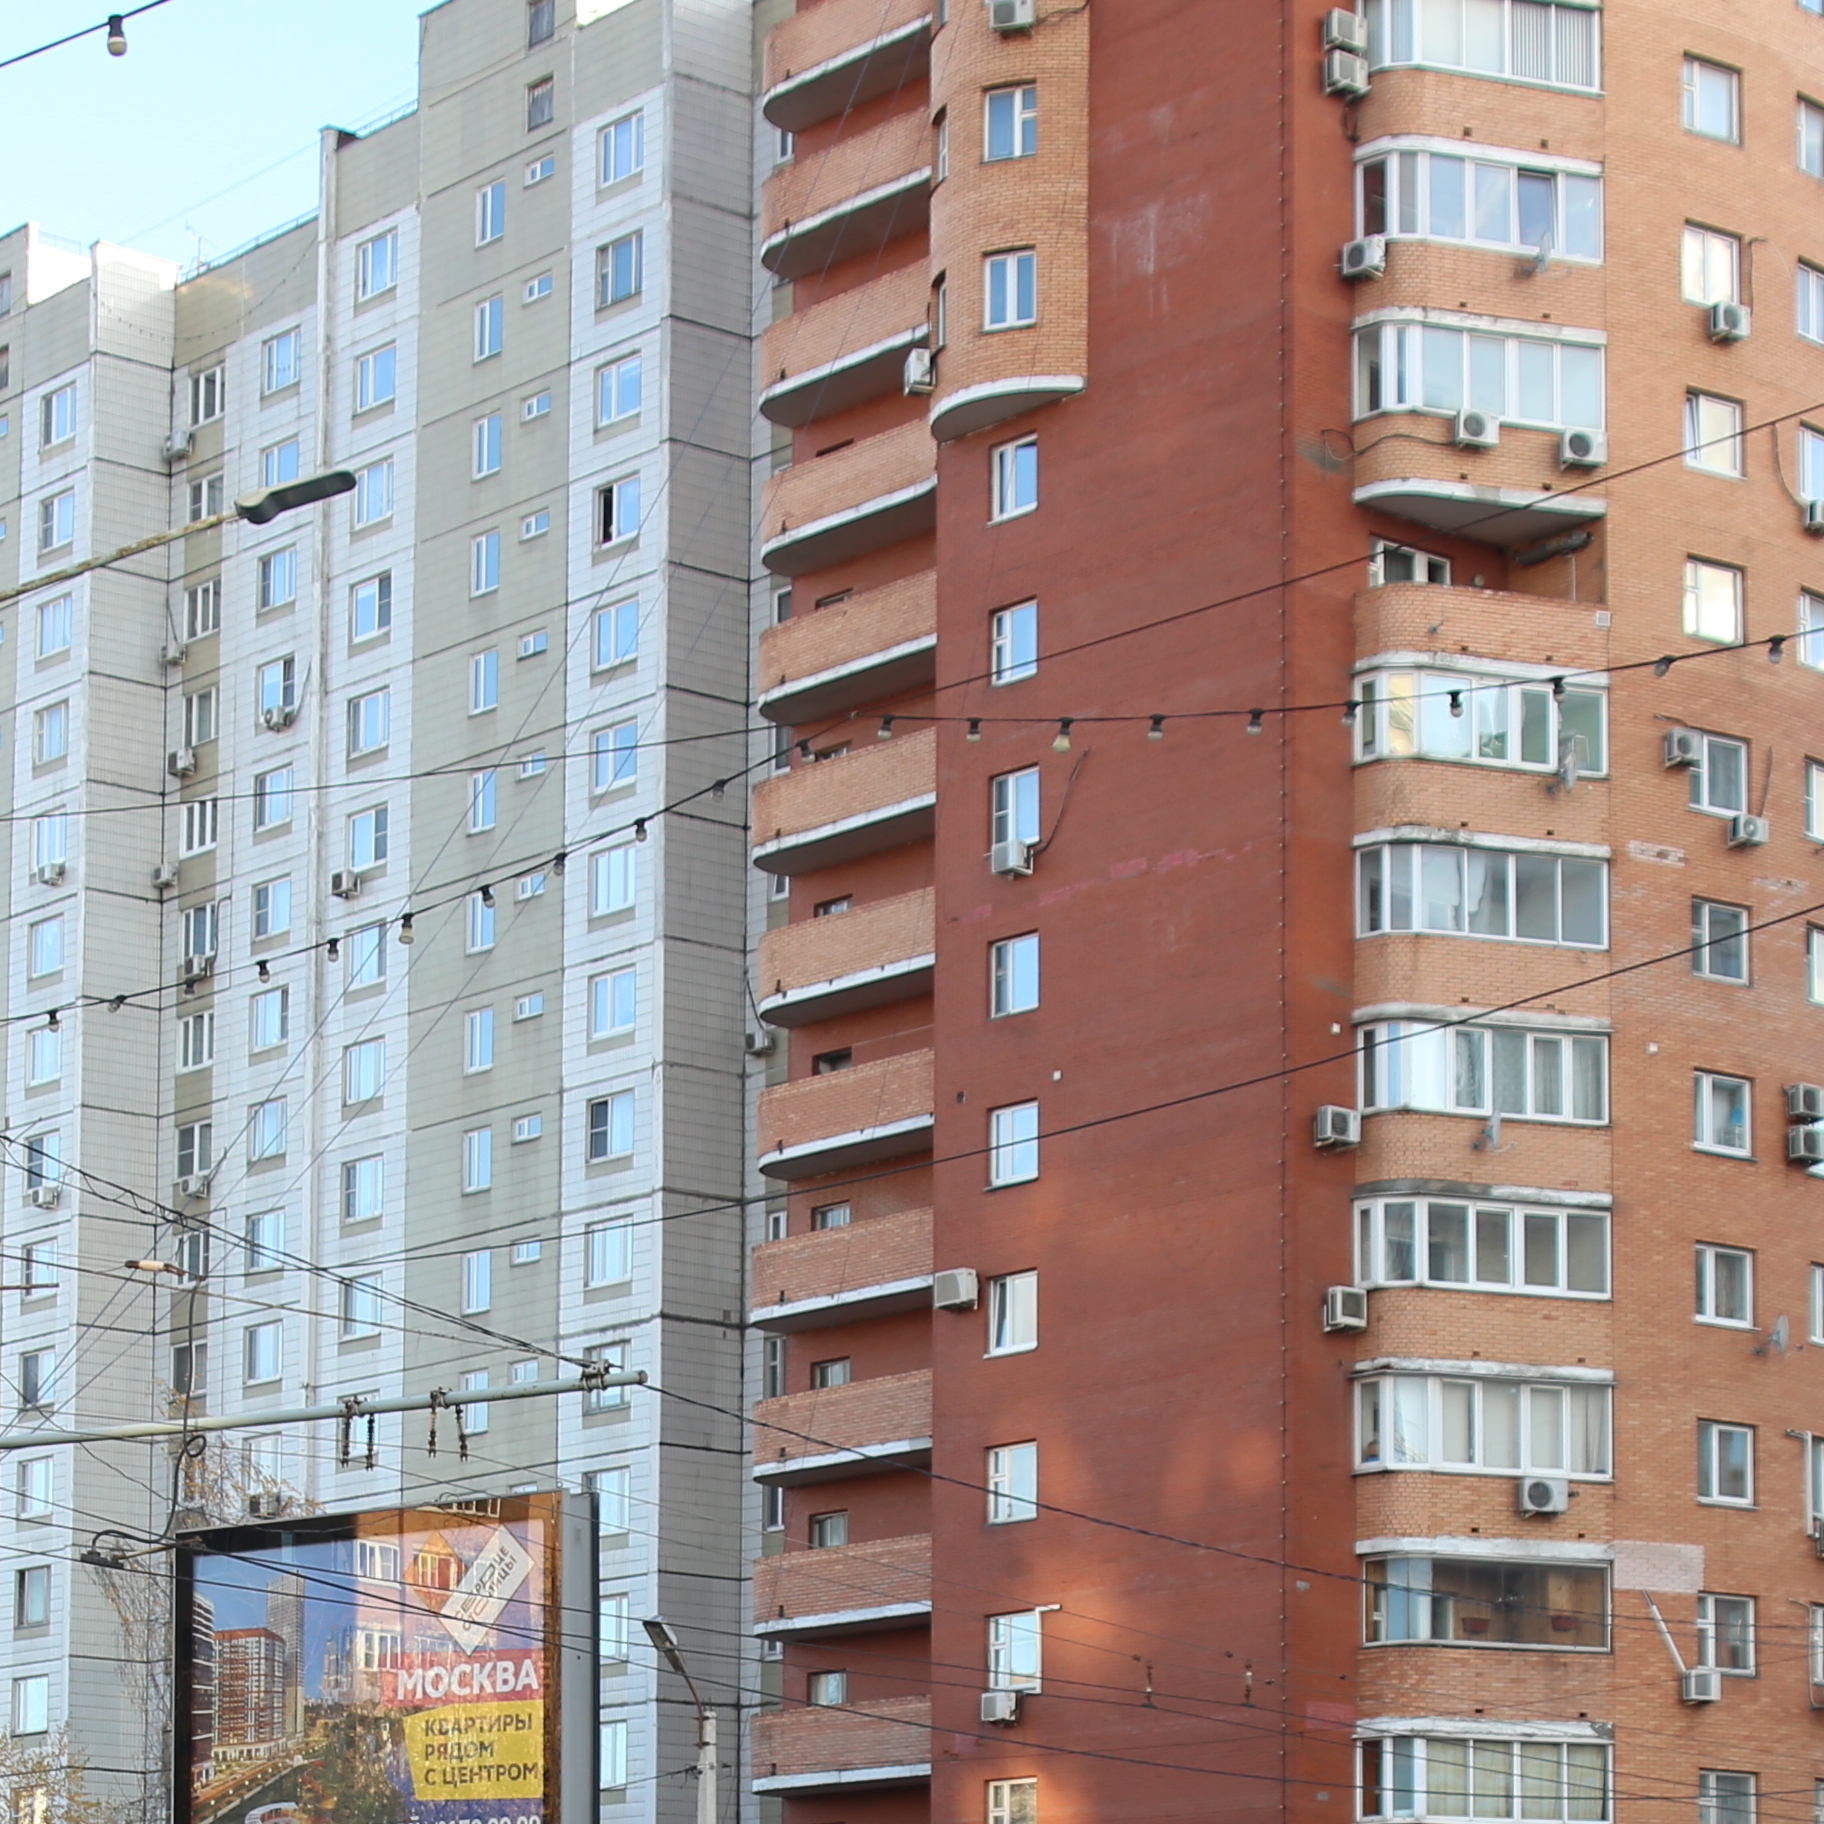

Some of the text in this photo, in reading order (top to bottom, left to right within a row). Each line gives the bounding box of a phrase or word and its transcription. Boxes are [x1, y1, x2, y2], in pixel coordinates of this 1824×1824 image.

[397, 1658, 540, 1700] МОСКВА
[425, 1713, 532, 1737] КВАРТИРЫ
[425, 1742, 495, 1764] РЯДОМ
[424, 1763, 539, 1789] С ЦЕНТРОМ
